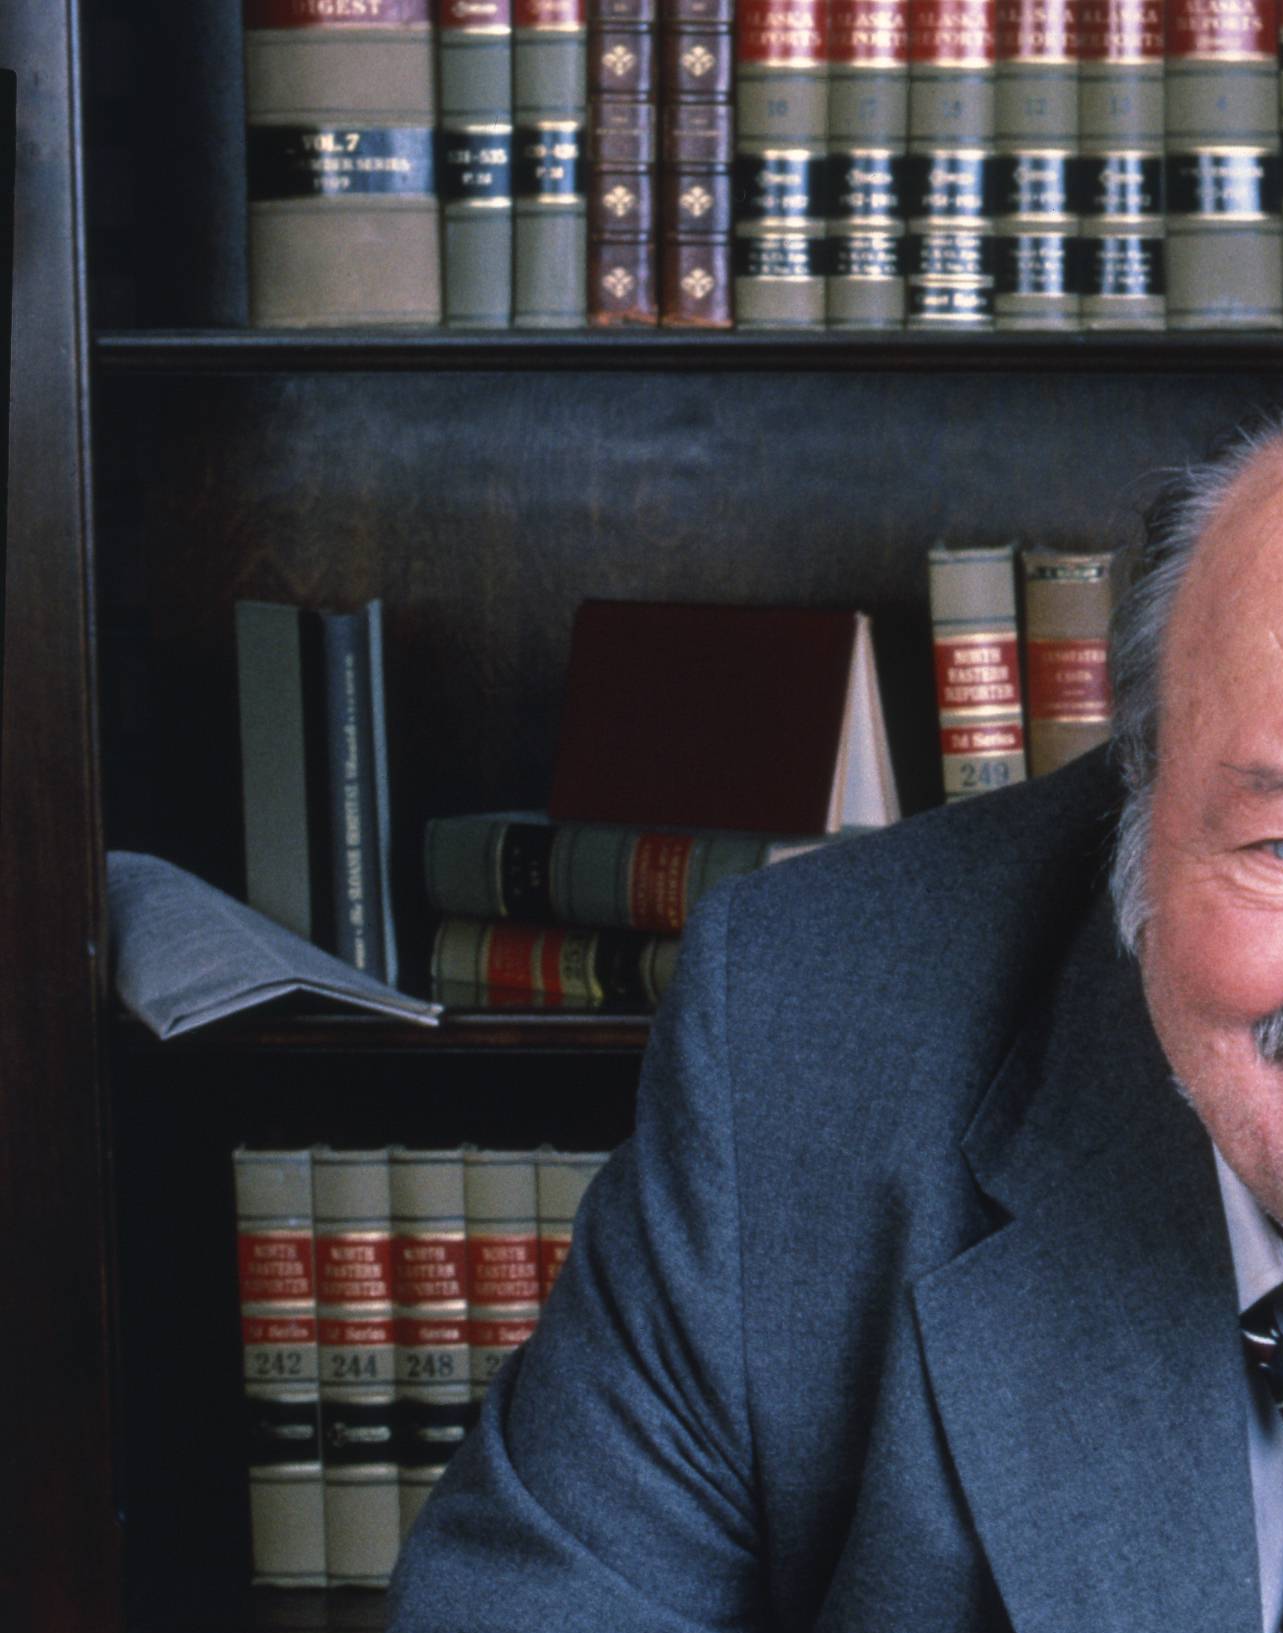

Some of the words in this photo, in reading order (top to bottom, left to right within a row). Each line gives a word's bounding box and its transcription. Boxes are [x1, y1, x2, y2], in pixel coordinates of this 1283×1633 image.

[255, 1352, 302, 1376] 242
[332, 1353, 379, 1378] 244
[406, 1353, 453, 1378] 248
